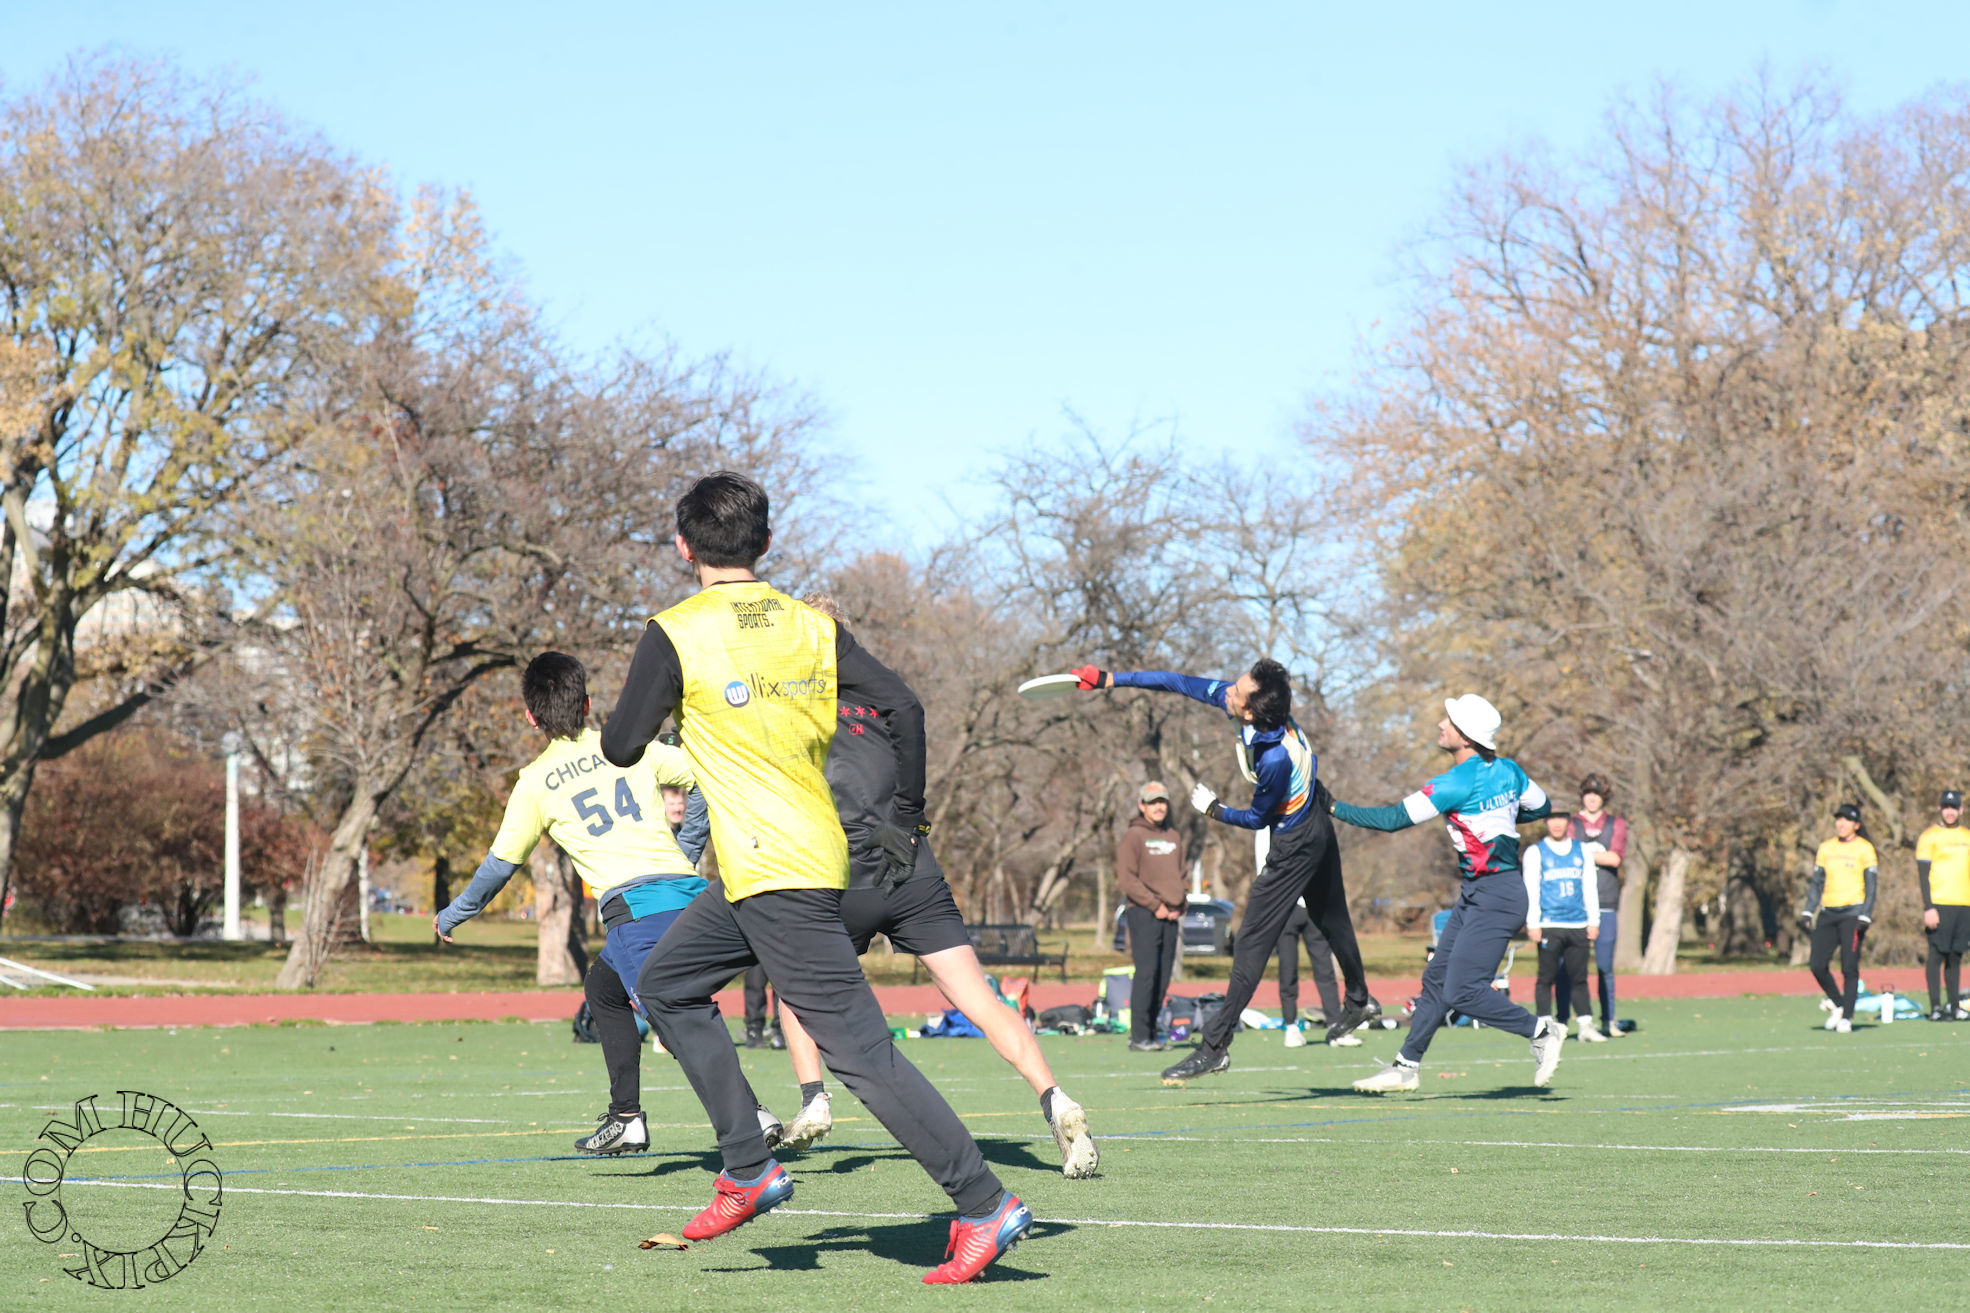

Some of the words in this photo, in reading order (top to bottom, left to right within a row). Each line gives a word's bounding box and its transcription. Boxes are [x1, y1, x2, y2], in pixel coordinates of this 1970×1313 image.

[730, 598, 784, 613] INTENTIONAL
[737, 613, 774, 629] SPORTS.
[545, 754, 607, 790] CHICA
[571, 777, 643, 837] 54
